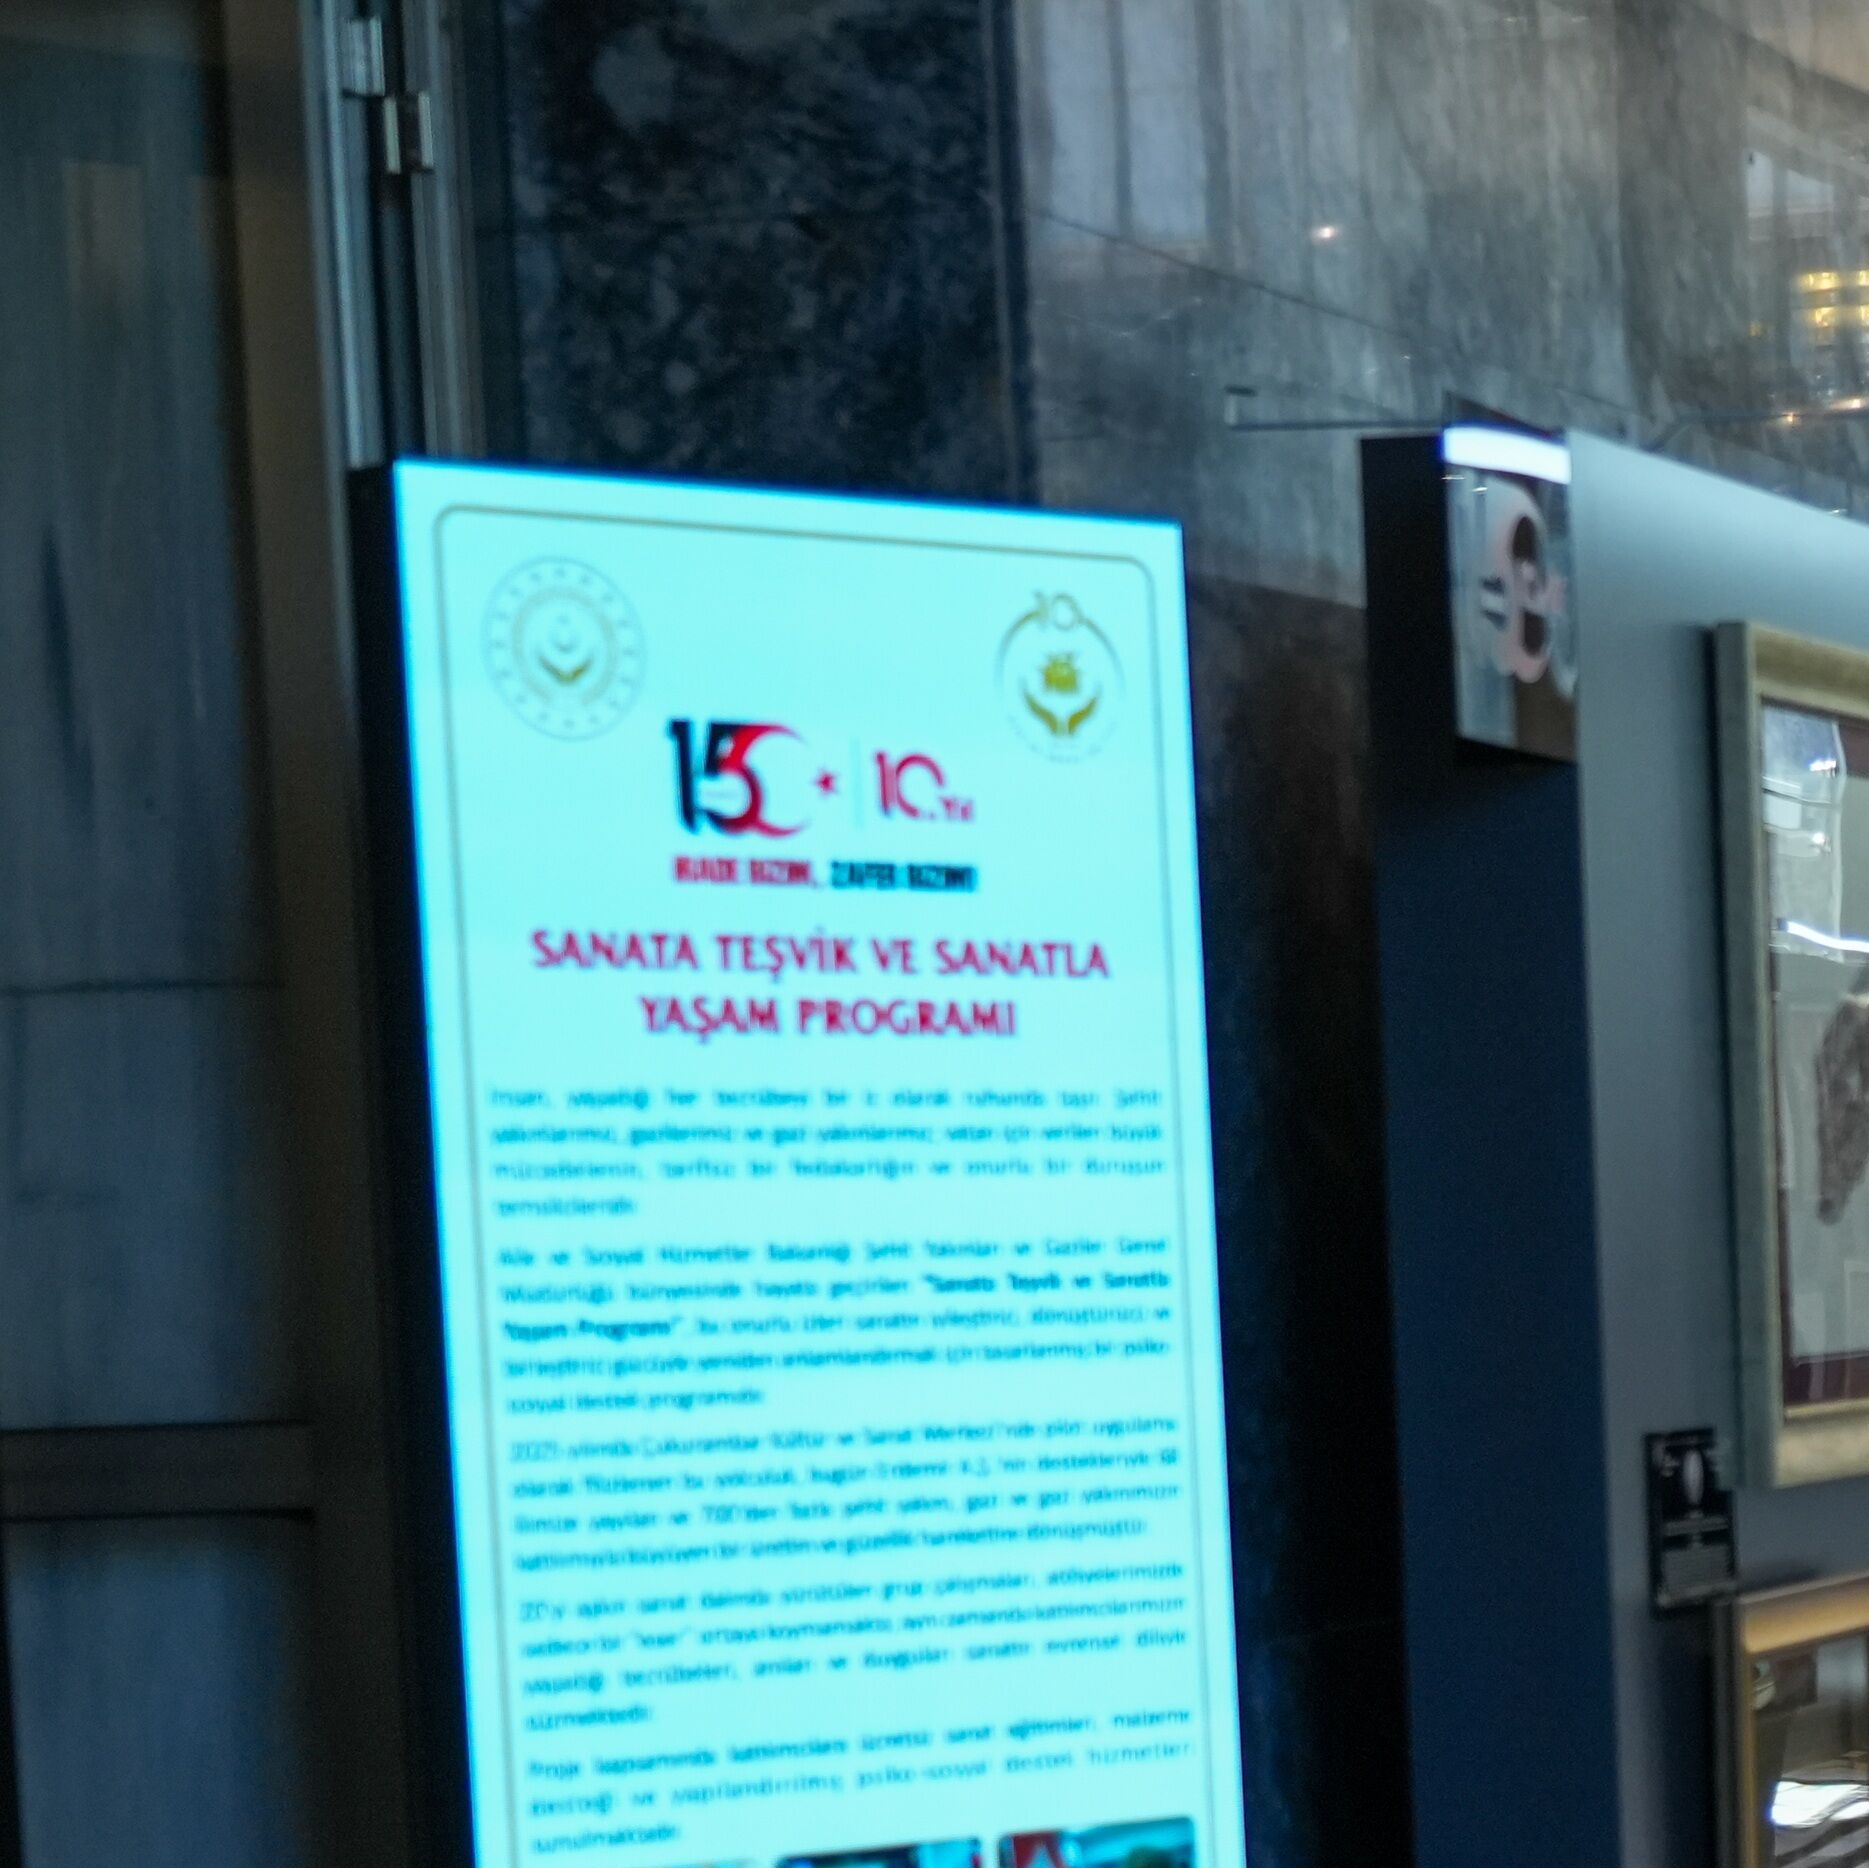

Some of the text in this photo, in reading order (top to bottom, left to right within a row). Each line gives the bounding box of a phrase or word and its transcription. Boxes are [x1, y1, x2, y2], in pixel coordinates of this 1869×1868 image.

[530, 921, 1108, 985] SANATA TEŞVİK VE SANATLA
[640, 995, 1017, 1044] YAŞAM PROGRAMI
